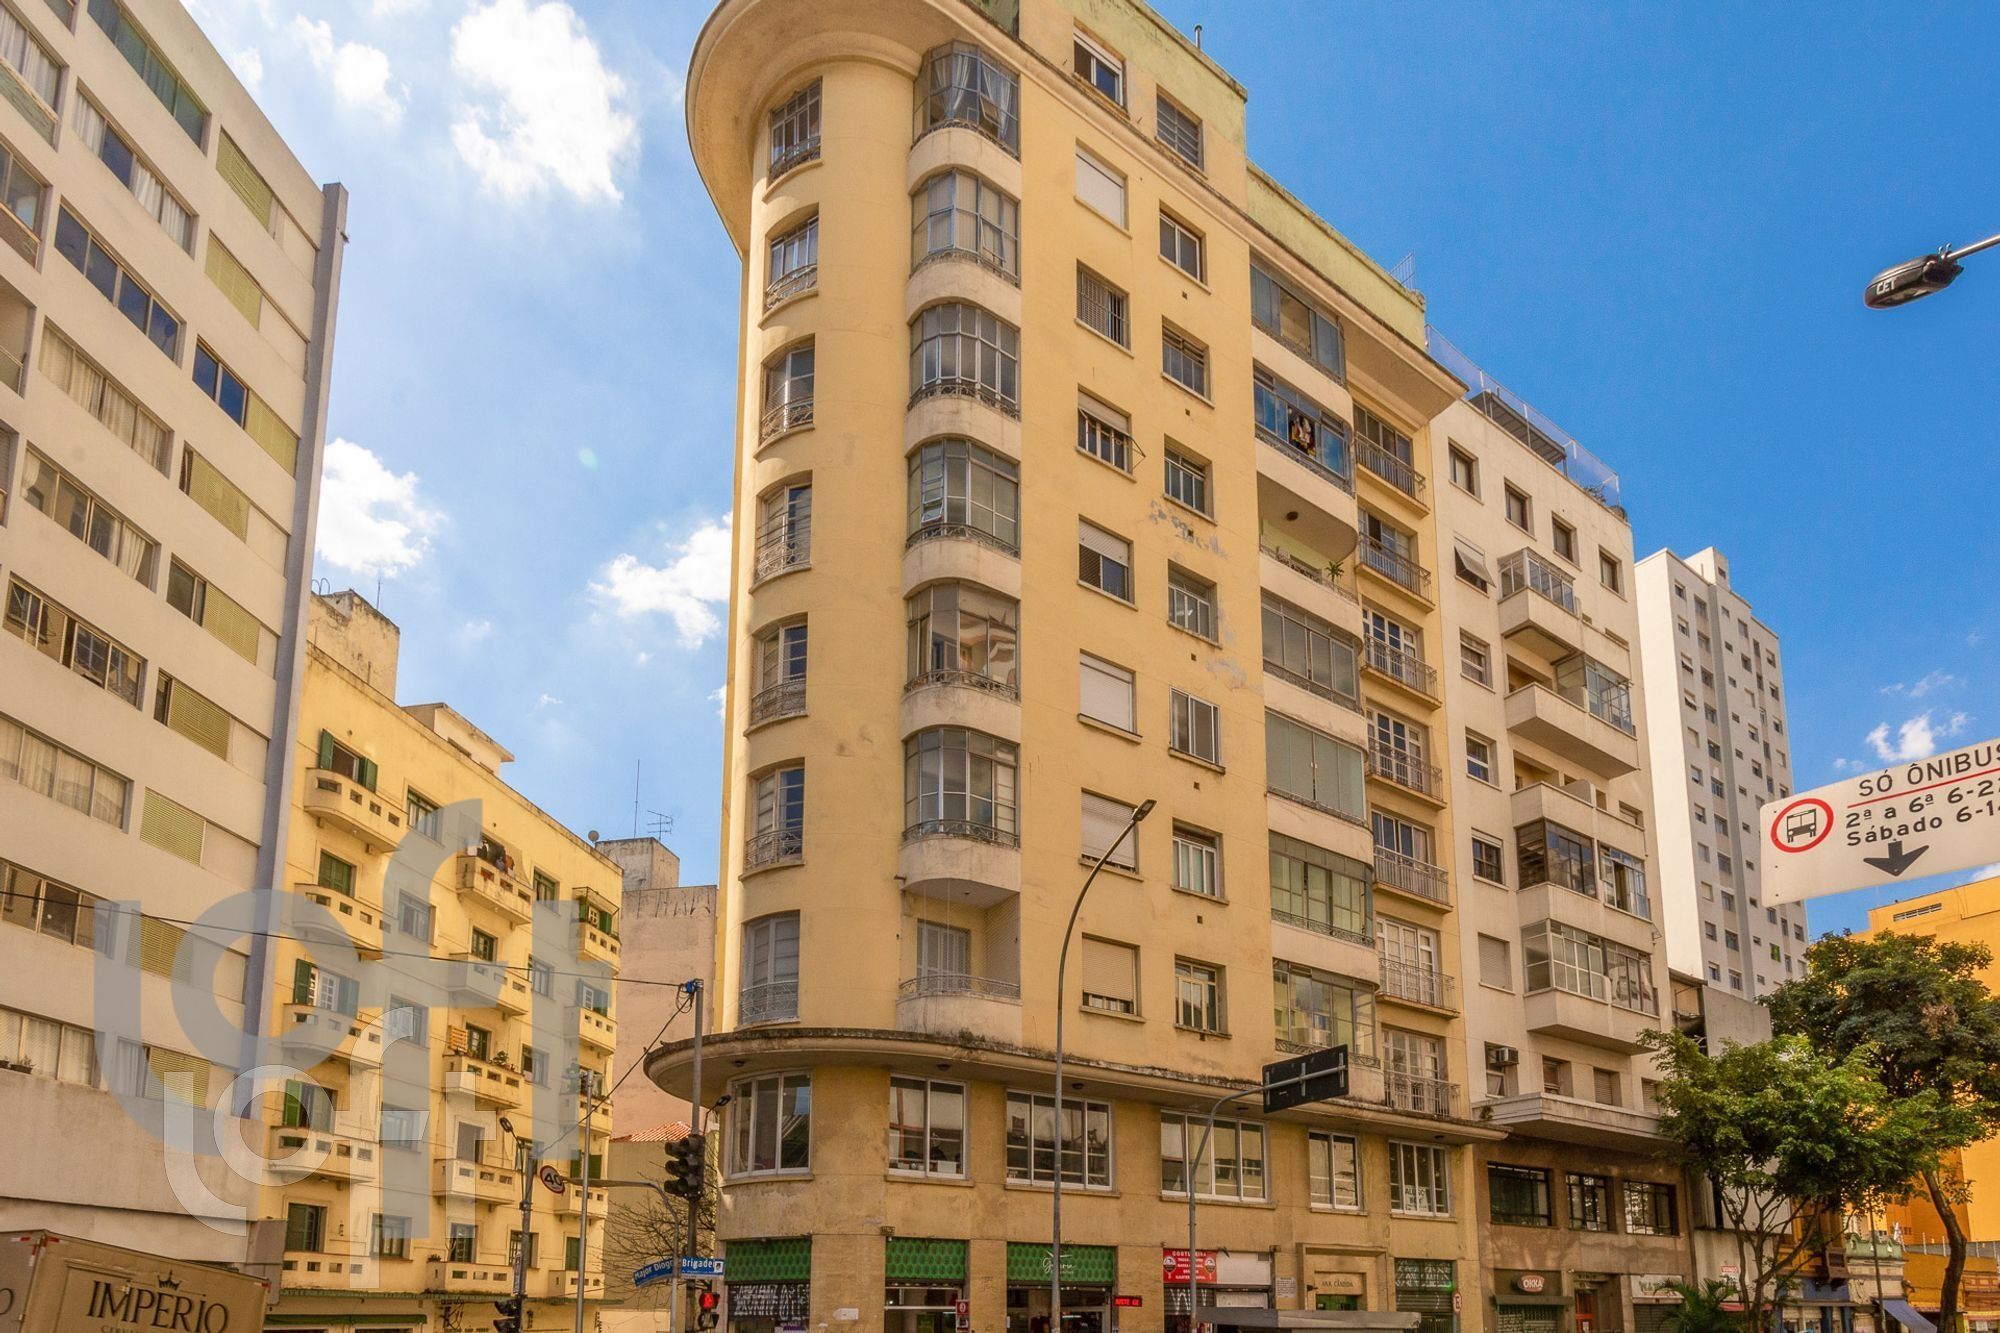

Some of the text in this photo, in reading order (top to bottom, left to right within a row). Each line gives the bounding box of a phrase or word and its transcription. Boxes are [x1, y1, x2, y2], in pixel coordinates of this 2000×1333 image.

[1876, 278, 1895, 295] CET
[1858, 769, 1893, 797] SÓ
[1846, 777, 2000, 829] 2ª a 6ª 6-2
[1846, 800, 2000, 846] Sábado 6-1
[544, 1173, 563, 1186] 40
[634, 1266, 652, 1279] Major
